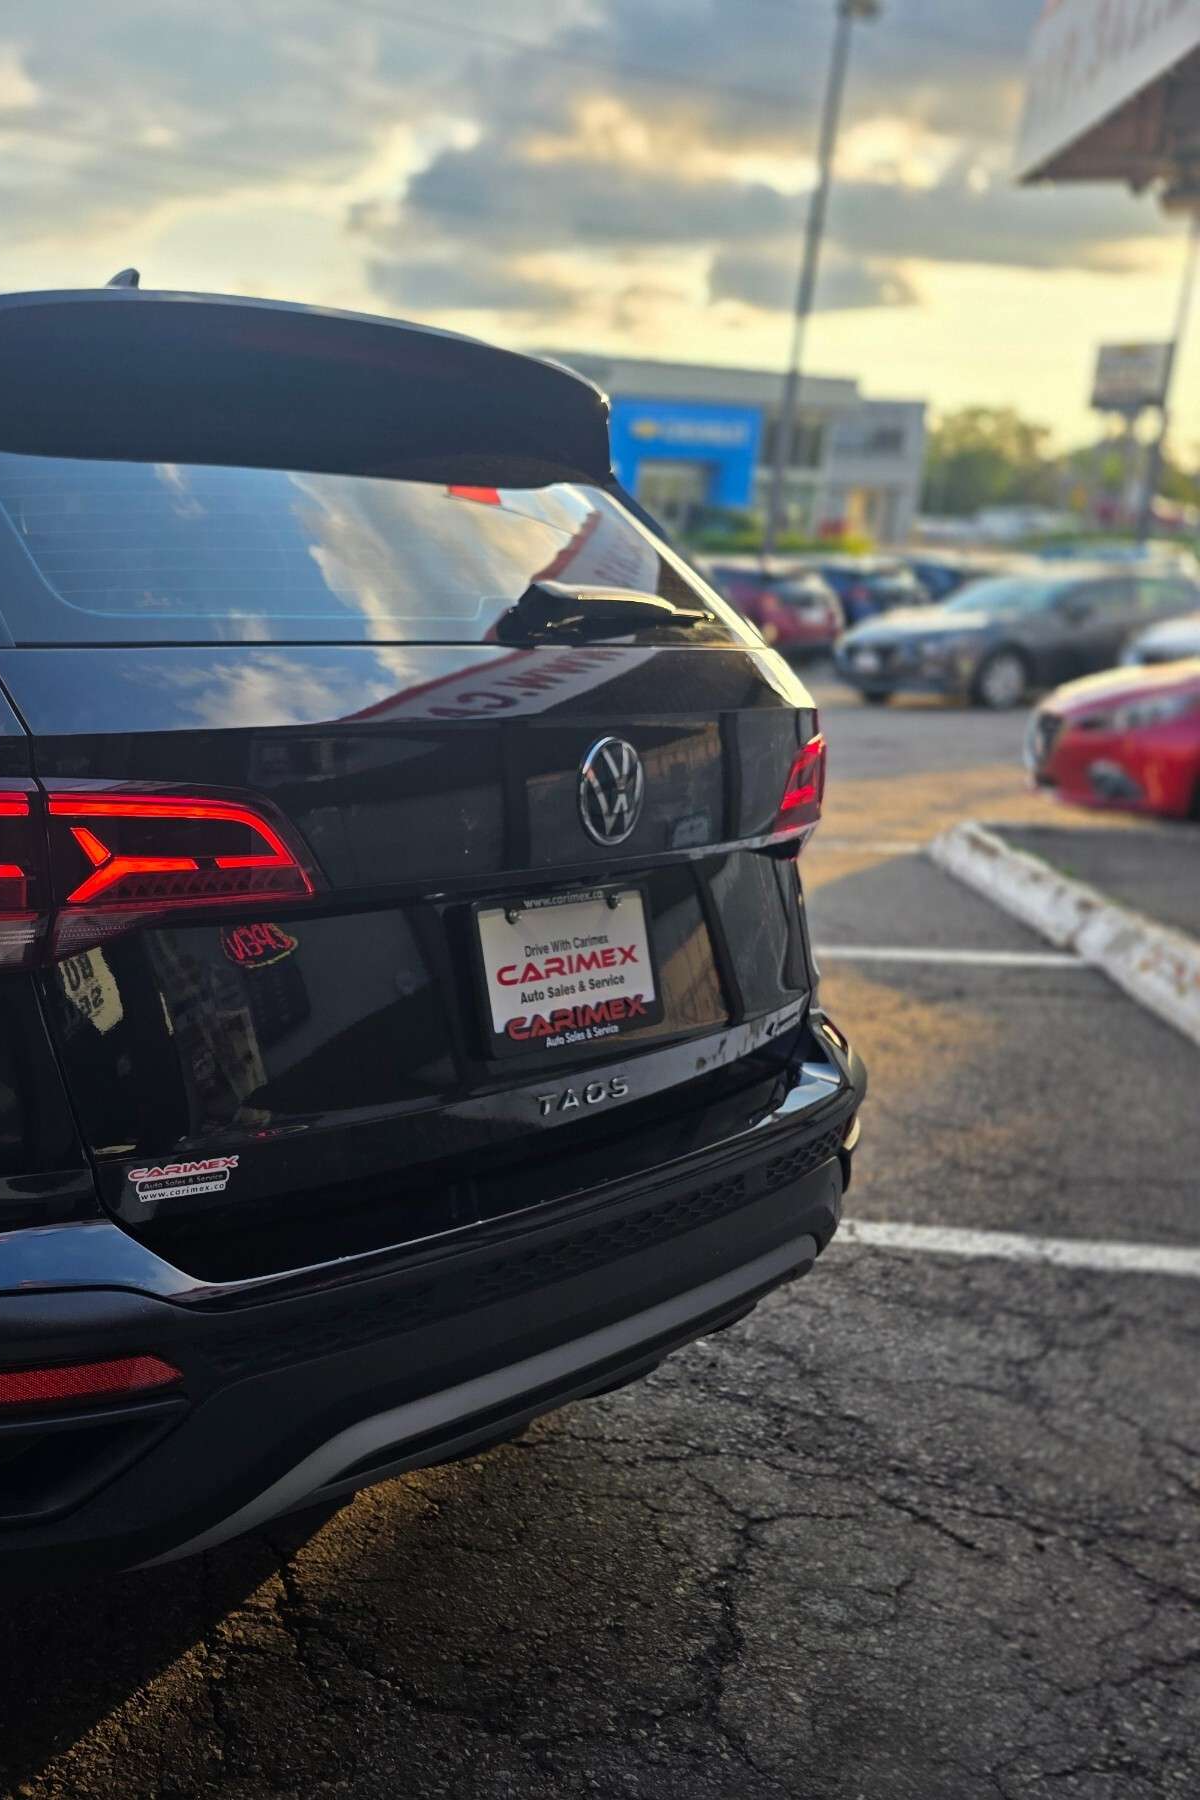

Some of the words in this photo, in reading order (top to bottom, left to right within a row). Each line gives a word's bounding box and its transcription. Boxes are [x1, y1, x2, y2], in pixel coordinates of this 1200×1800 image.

[524, 943, 549, 958] Drive
[550, 939, 571, 952] With
[573, 935, 609, 950] Carimex
[496, 945, 639, 986] CARIMEX
[521, 991, 544, 1005] Auto
[547, 984, 576, 999] Sales
[578, 980, 587, 993] &
[588, 974, 626, 991] Service
[506, 994, 647, 1041] CARIMEX
[546, 1035, 565, 1048] Auto
[565, 1029, 585, 1043] Sales
[593, 1023, 620, 1039] Service
[538, 1076, 630, 1116] TAOS
[130, 1157, 238, 1179] CARIMEX
[144, 1182, 163, 1190] Auto
[166, 1178, 186, 1187] Sales
[197, 1173, 224, 1182] Service
